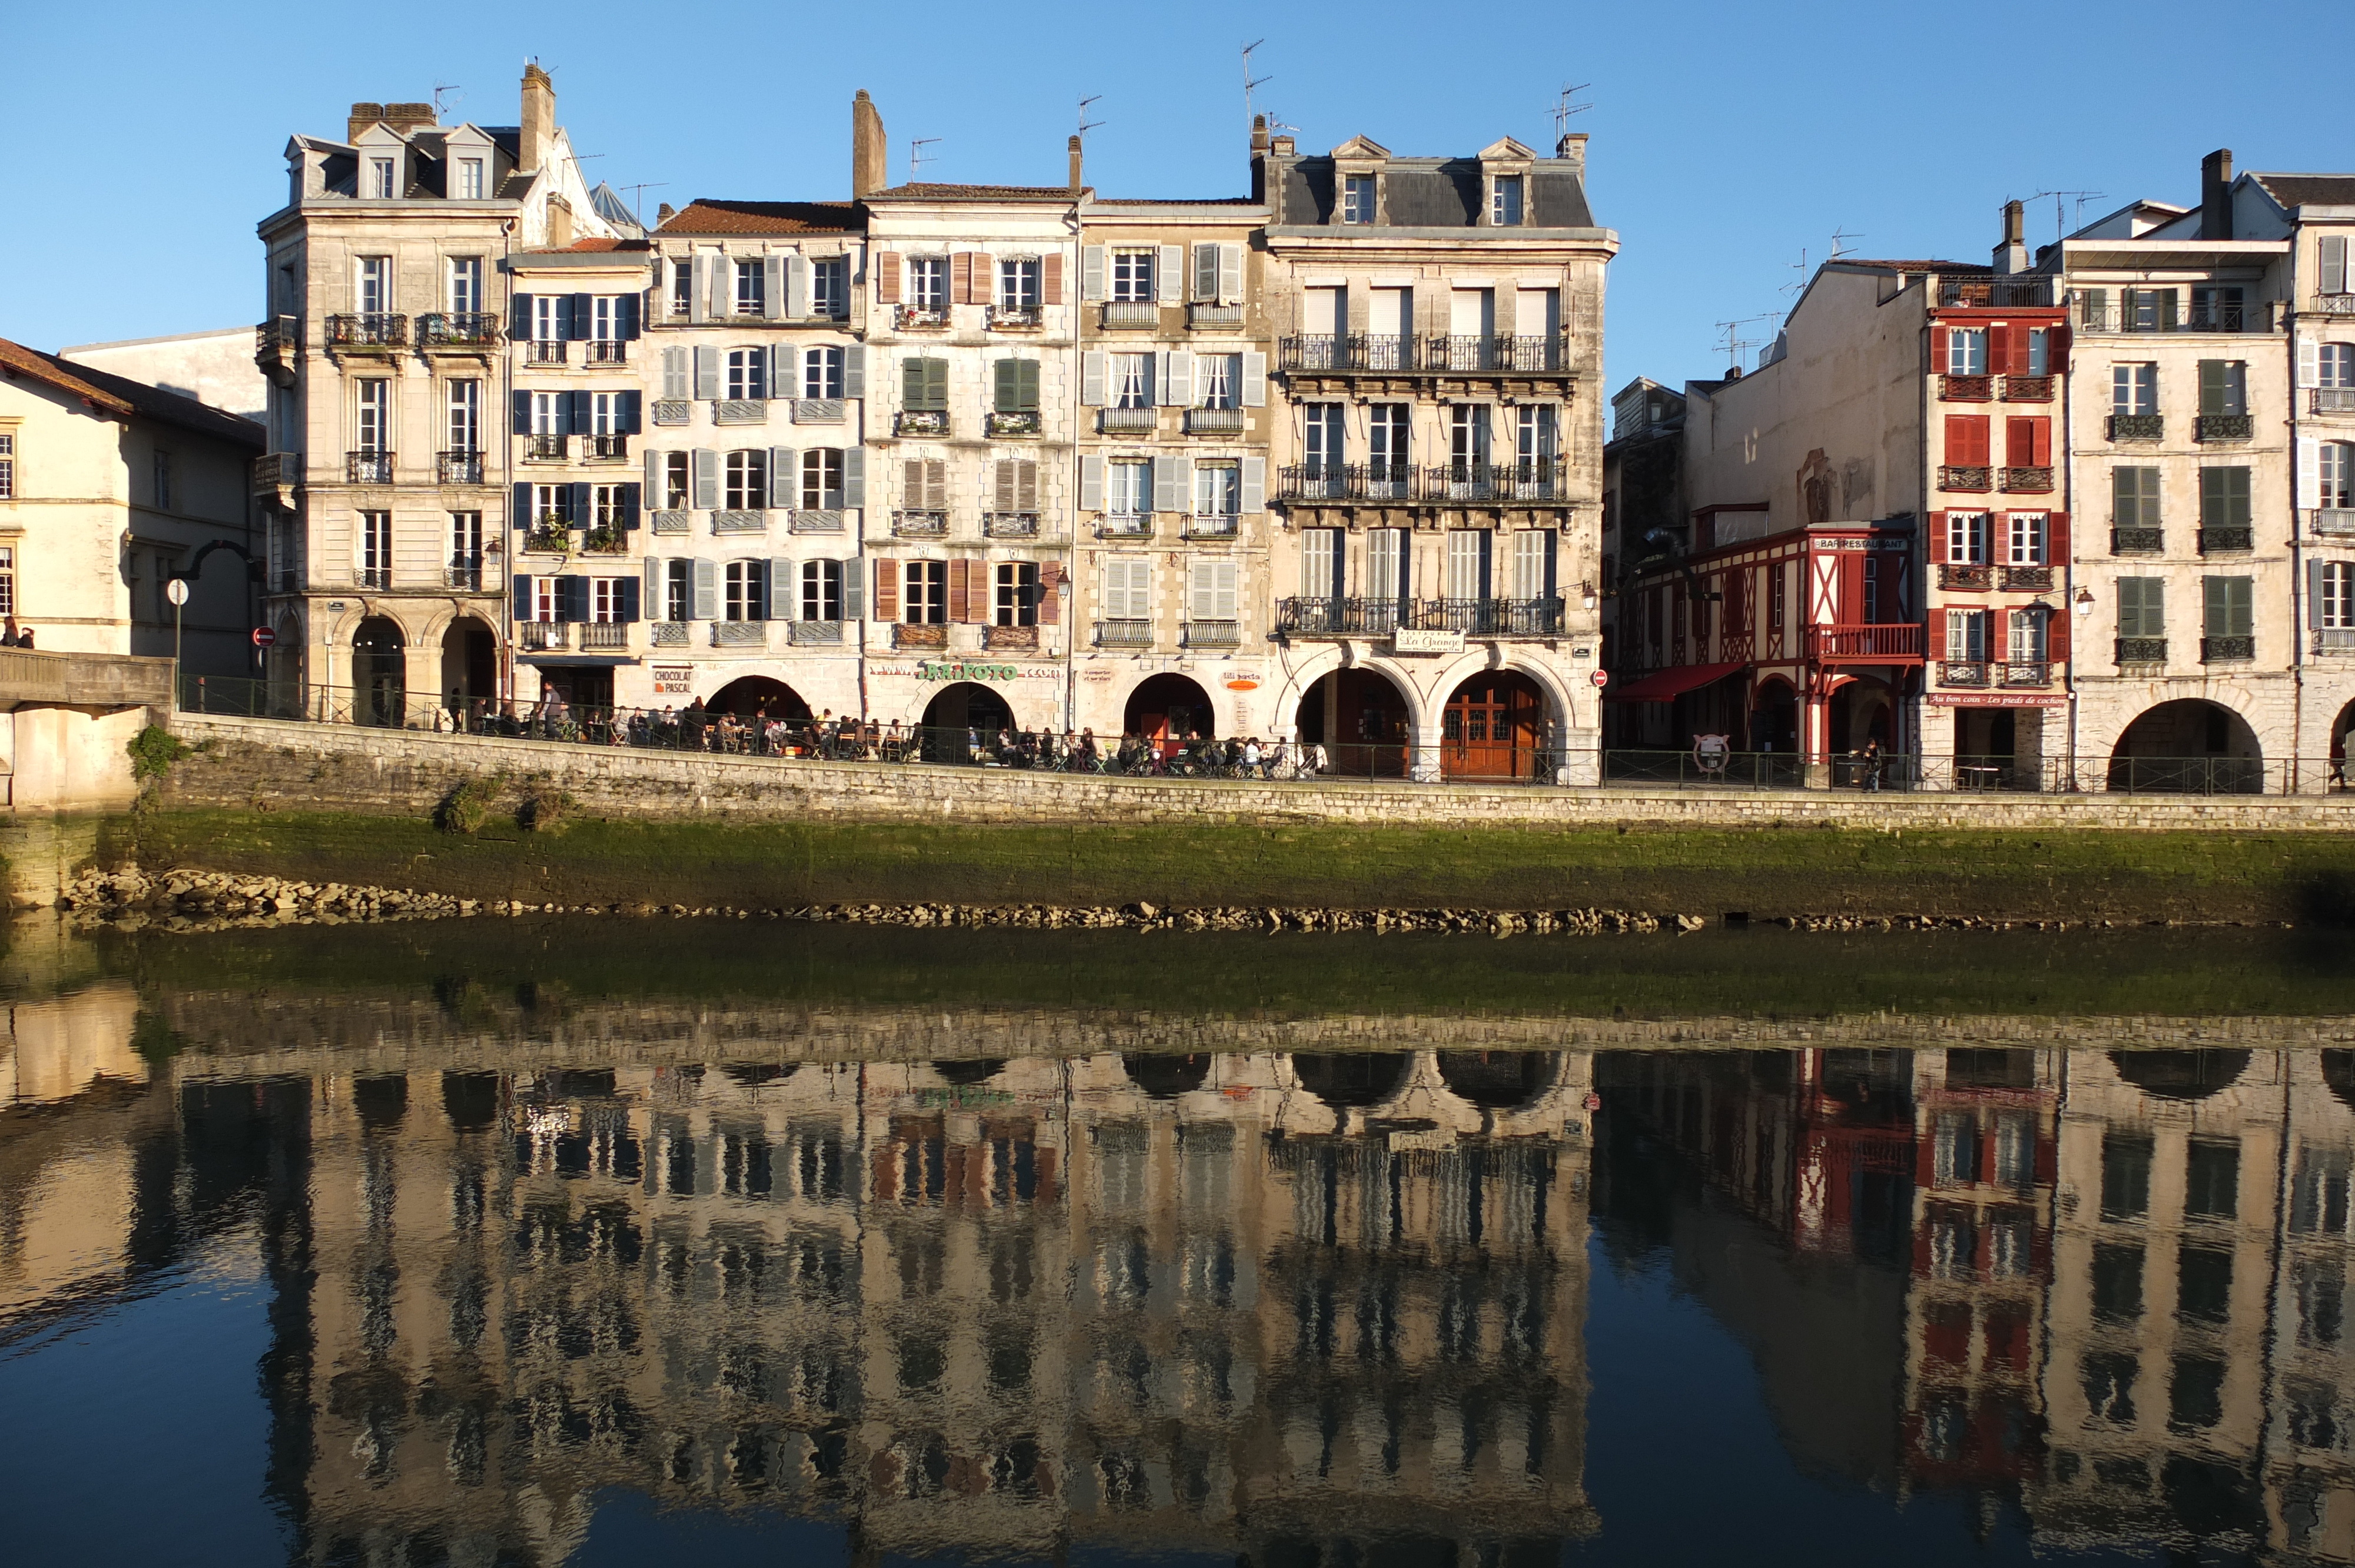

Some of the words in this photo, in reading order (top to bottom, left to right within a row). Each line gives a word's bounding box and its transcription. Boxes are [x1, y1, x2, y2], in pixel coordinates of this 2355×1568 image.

[1400, 636, 1418, 645] La
[1422, 636, 1460, 648] Grange
[655, 671, 691, 680] CHOCOLAT
[666, 683, 691, 693] PASCAL
[2000, 696, 2023, 705] pieds
